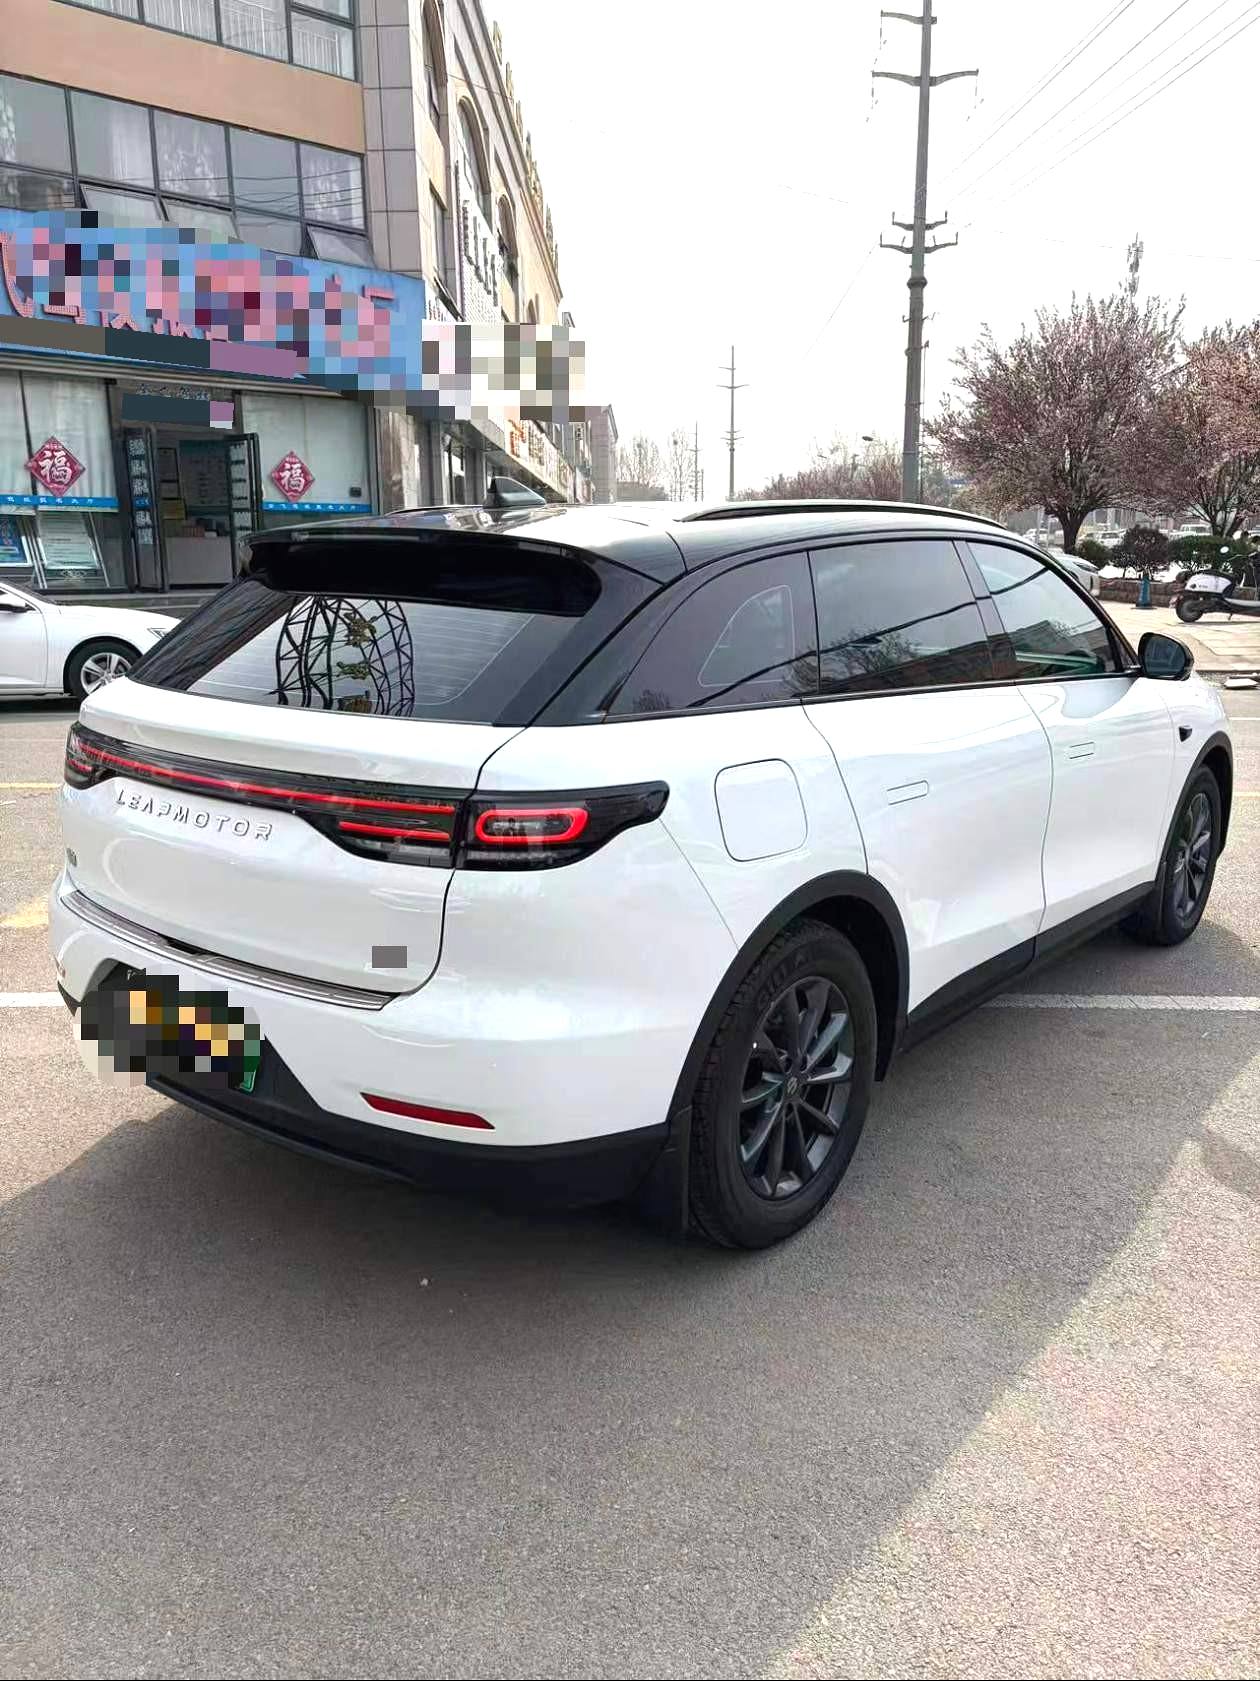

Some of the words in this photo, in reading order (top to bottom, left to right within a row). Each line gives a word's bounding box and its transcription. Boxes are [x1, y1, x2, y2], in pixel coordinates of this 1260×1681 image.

[38, 450, 73, 484] 福
[279, 463, 306, 492] 福
[115, 788, 273, 841] LEAPMOTOR
